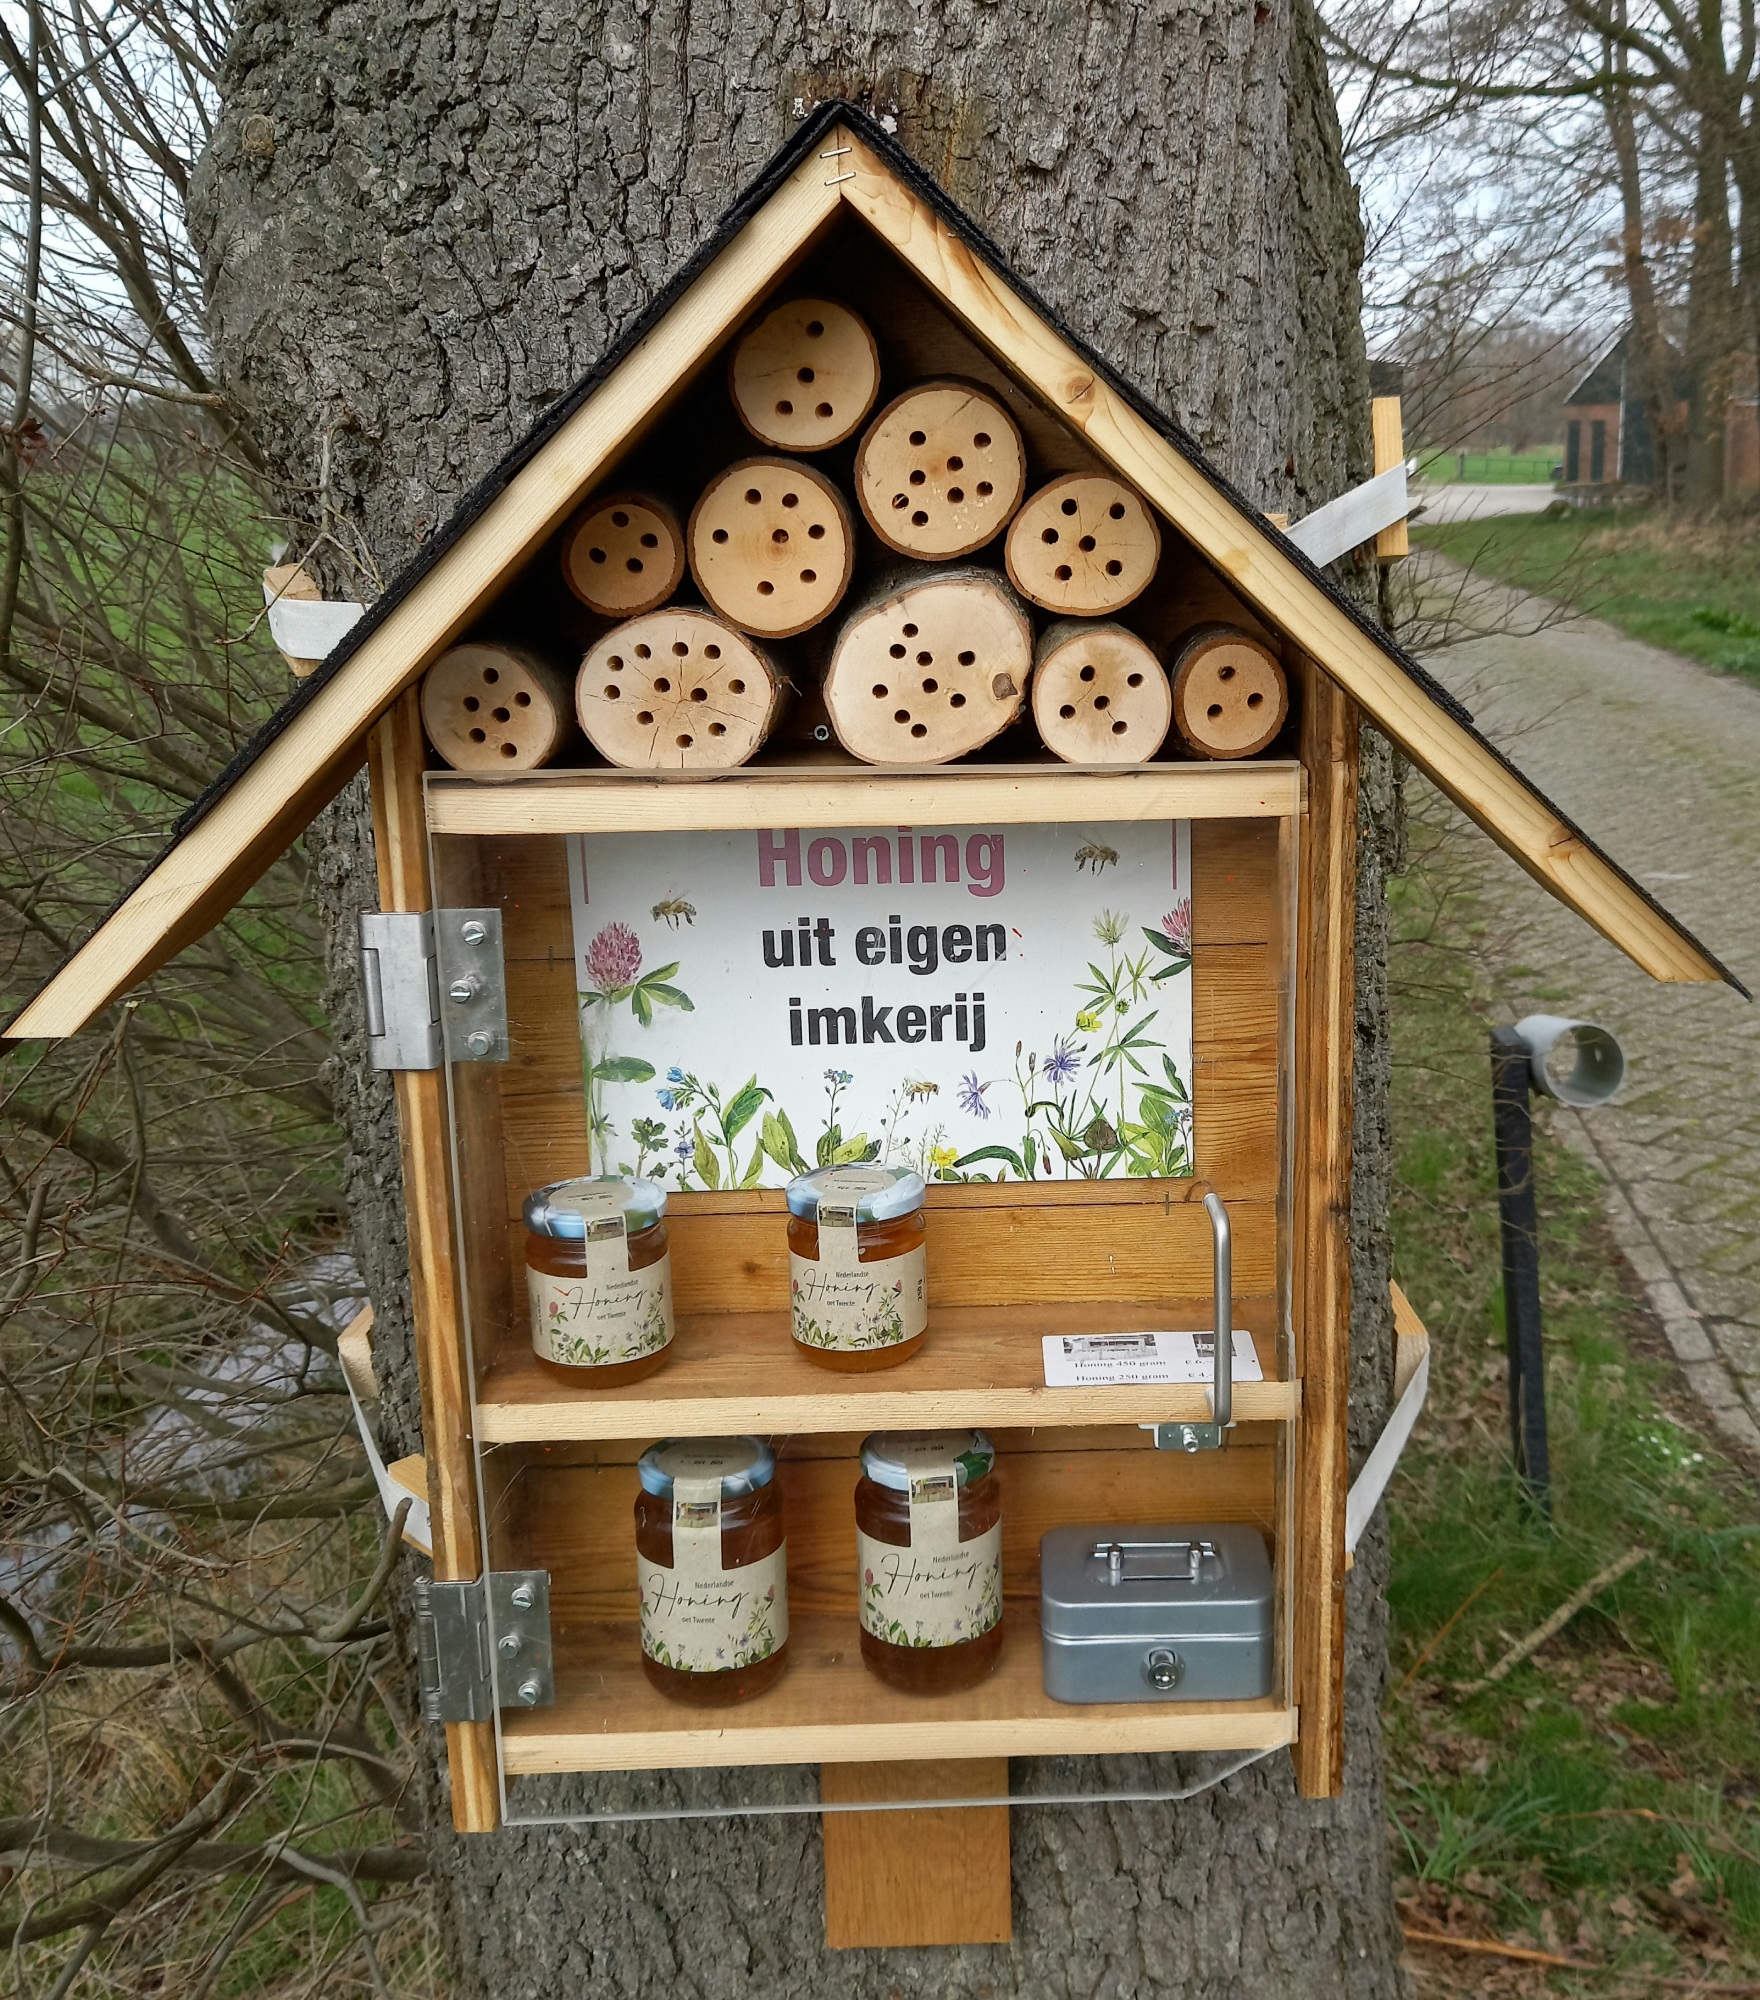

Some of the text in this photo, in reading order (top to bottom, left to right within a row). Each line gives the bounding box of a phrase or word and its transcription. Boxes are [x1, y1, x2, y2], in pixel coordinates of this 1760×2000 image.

[757, 826, 1006, 898] Honing
[762, 914, 1007, 976] uit eigen
[788, 992, 987, 1052] imkerij
[566, 1286, 648, 1320] Honing
[803, 1268, 880, 1303] Honing
[648, 1573, 750, 1619] Honing
[880, 1553, 983, 1596] Honing
